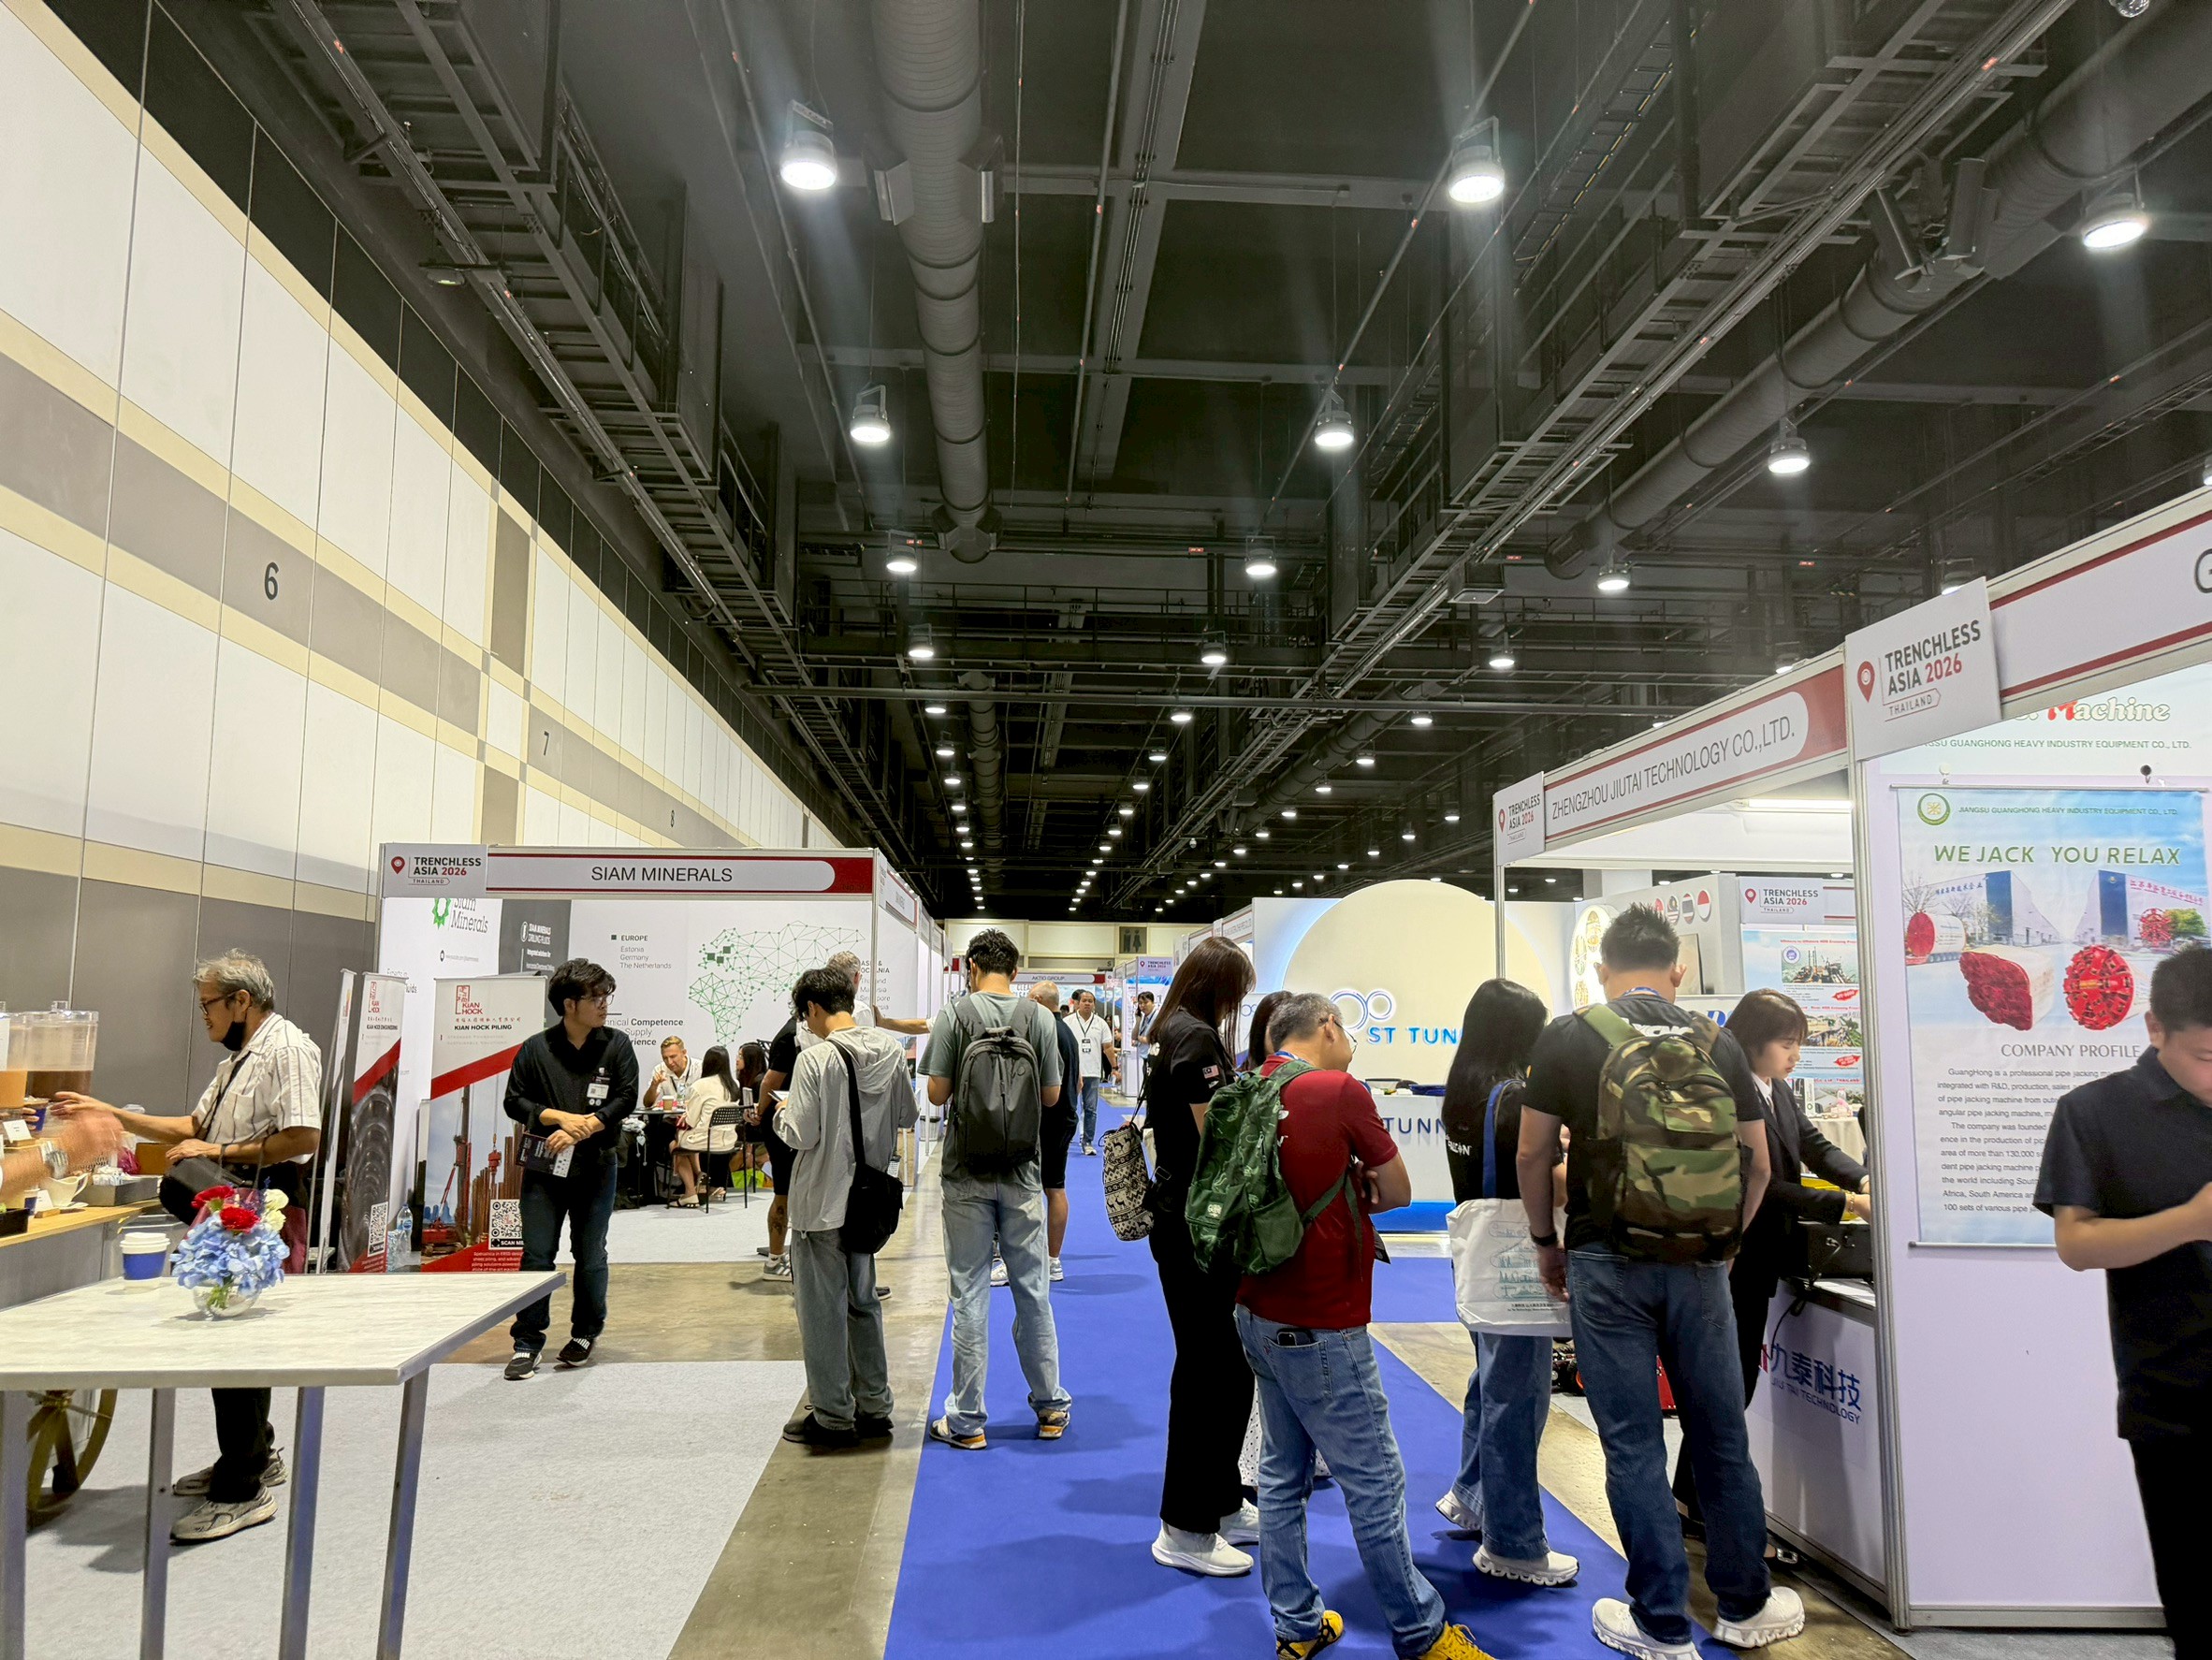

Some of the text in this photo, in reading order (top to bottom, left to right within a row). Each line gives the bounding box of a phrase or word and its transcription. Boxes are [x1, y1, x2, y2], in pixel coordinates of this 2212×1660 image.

[264, 562, 280, 600] 6
[1885, 619, 1981, 672] TRENCHLESS
[1888, 652, 1962, 696] ASIA 2026
[1889, 694, 1932, 716] THAILAND
[2046, 697, 2171, 721] Machine
[543, 731, 549, 756] 7
[1950, 739, 2012, 748] GUANGHONG
[2096, 740, 2149, 749] EQUIPMENT
[1552, 786, 1608, 821] ZHENGZHOU
[1610, 771, 1642, 800] JIUTAI
[1643, 737, 1729, 789] TECHNOLOGY
[1508, 794, 1541, 816] TRENCHLESS
[1508, 810, 1535, 831] ASIA 2026
[414, 856, 482, 866] TRENCHLESS
[1934, 845, 2180, 865] WE JACK YOU RELAX
[413, 866, 467, 876] ASIA 2026
[590, 866, 733, 882] SIAM MINERALS
[1763, 889, 1819, 897] TRENCHLESS
[1786, 897, 1808, 906] 2026
[450, 910, 488, 934] Minerals
[619, 954, 649, 963] Germany
[631, 1018, 684, 1029] Competence
[625, 1027, 652, 1038] Supply
[1367, 1027, 1463, 1044] ST TUN
[633, 1038, 657, 1046] rience
[2001, 1043, 2141, 1058] COMPANY PROFILE
[1948, 1068, 1993, 1077] GuangHong
[2009, 1070, 2053, 1078] professional
[2073, 1070, 2099, 1079] jacking
[1937, 1082, 1973, 1091] integrated
[1991, 1083, 2010, 1091] R&D,
[2012, 1084, 2050, 1092] production,
[1964, 1096, 1990, 1104] jacking
[1939, 1109, 1966, 1117] angular
[1985, 1110, 2009, 1118] jacking
[1967, 1123, 2000, 1131] company
[1980, 1177, 2015, 1186] including
[1771, 1343, 1862, 1412] 九泰科技
[1800, 1390, 1860, 1424] TECHNOLOGY
